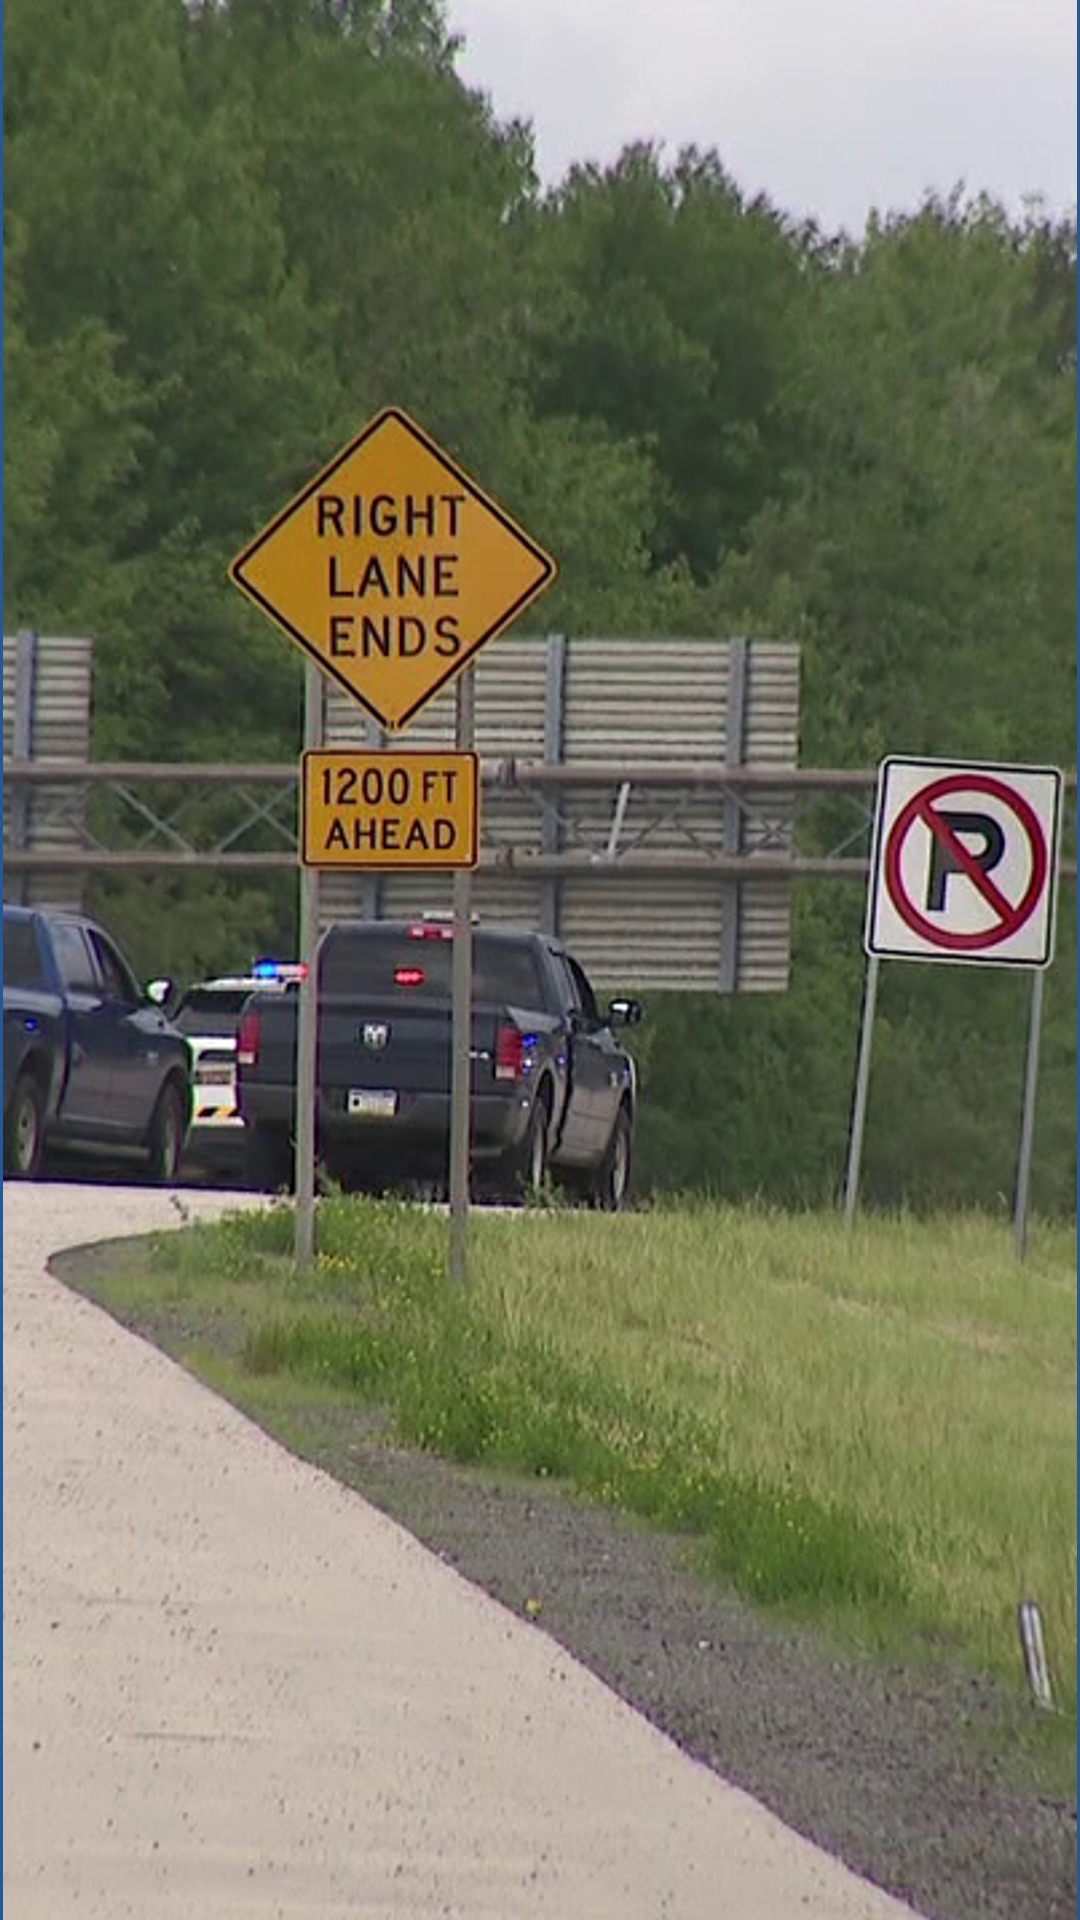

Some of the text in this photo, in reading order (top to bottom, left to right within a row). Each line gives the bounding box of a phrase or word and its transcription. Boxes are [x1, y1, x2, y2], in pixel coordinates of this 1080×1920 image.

[316, 495, 466, 537] RIGHT
[328, 555, 459, 598] LANE
[329, 615, 461, 658] ENDS
[322, 767, 458, 806] 1200 FT
[324, 818, 457, 851] AHEAD
[926, 811, 1006, 911] P
